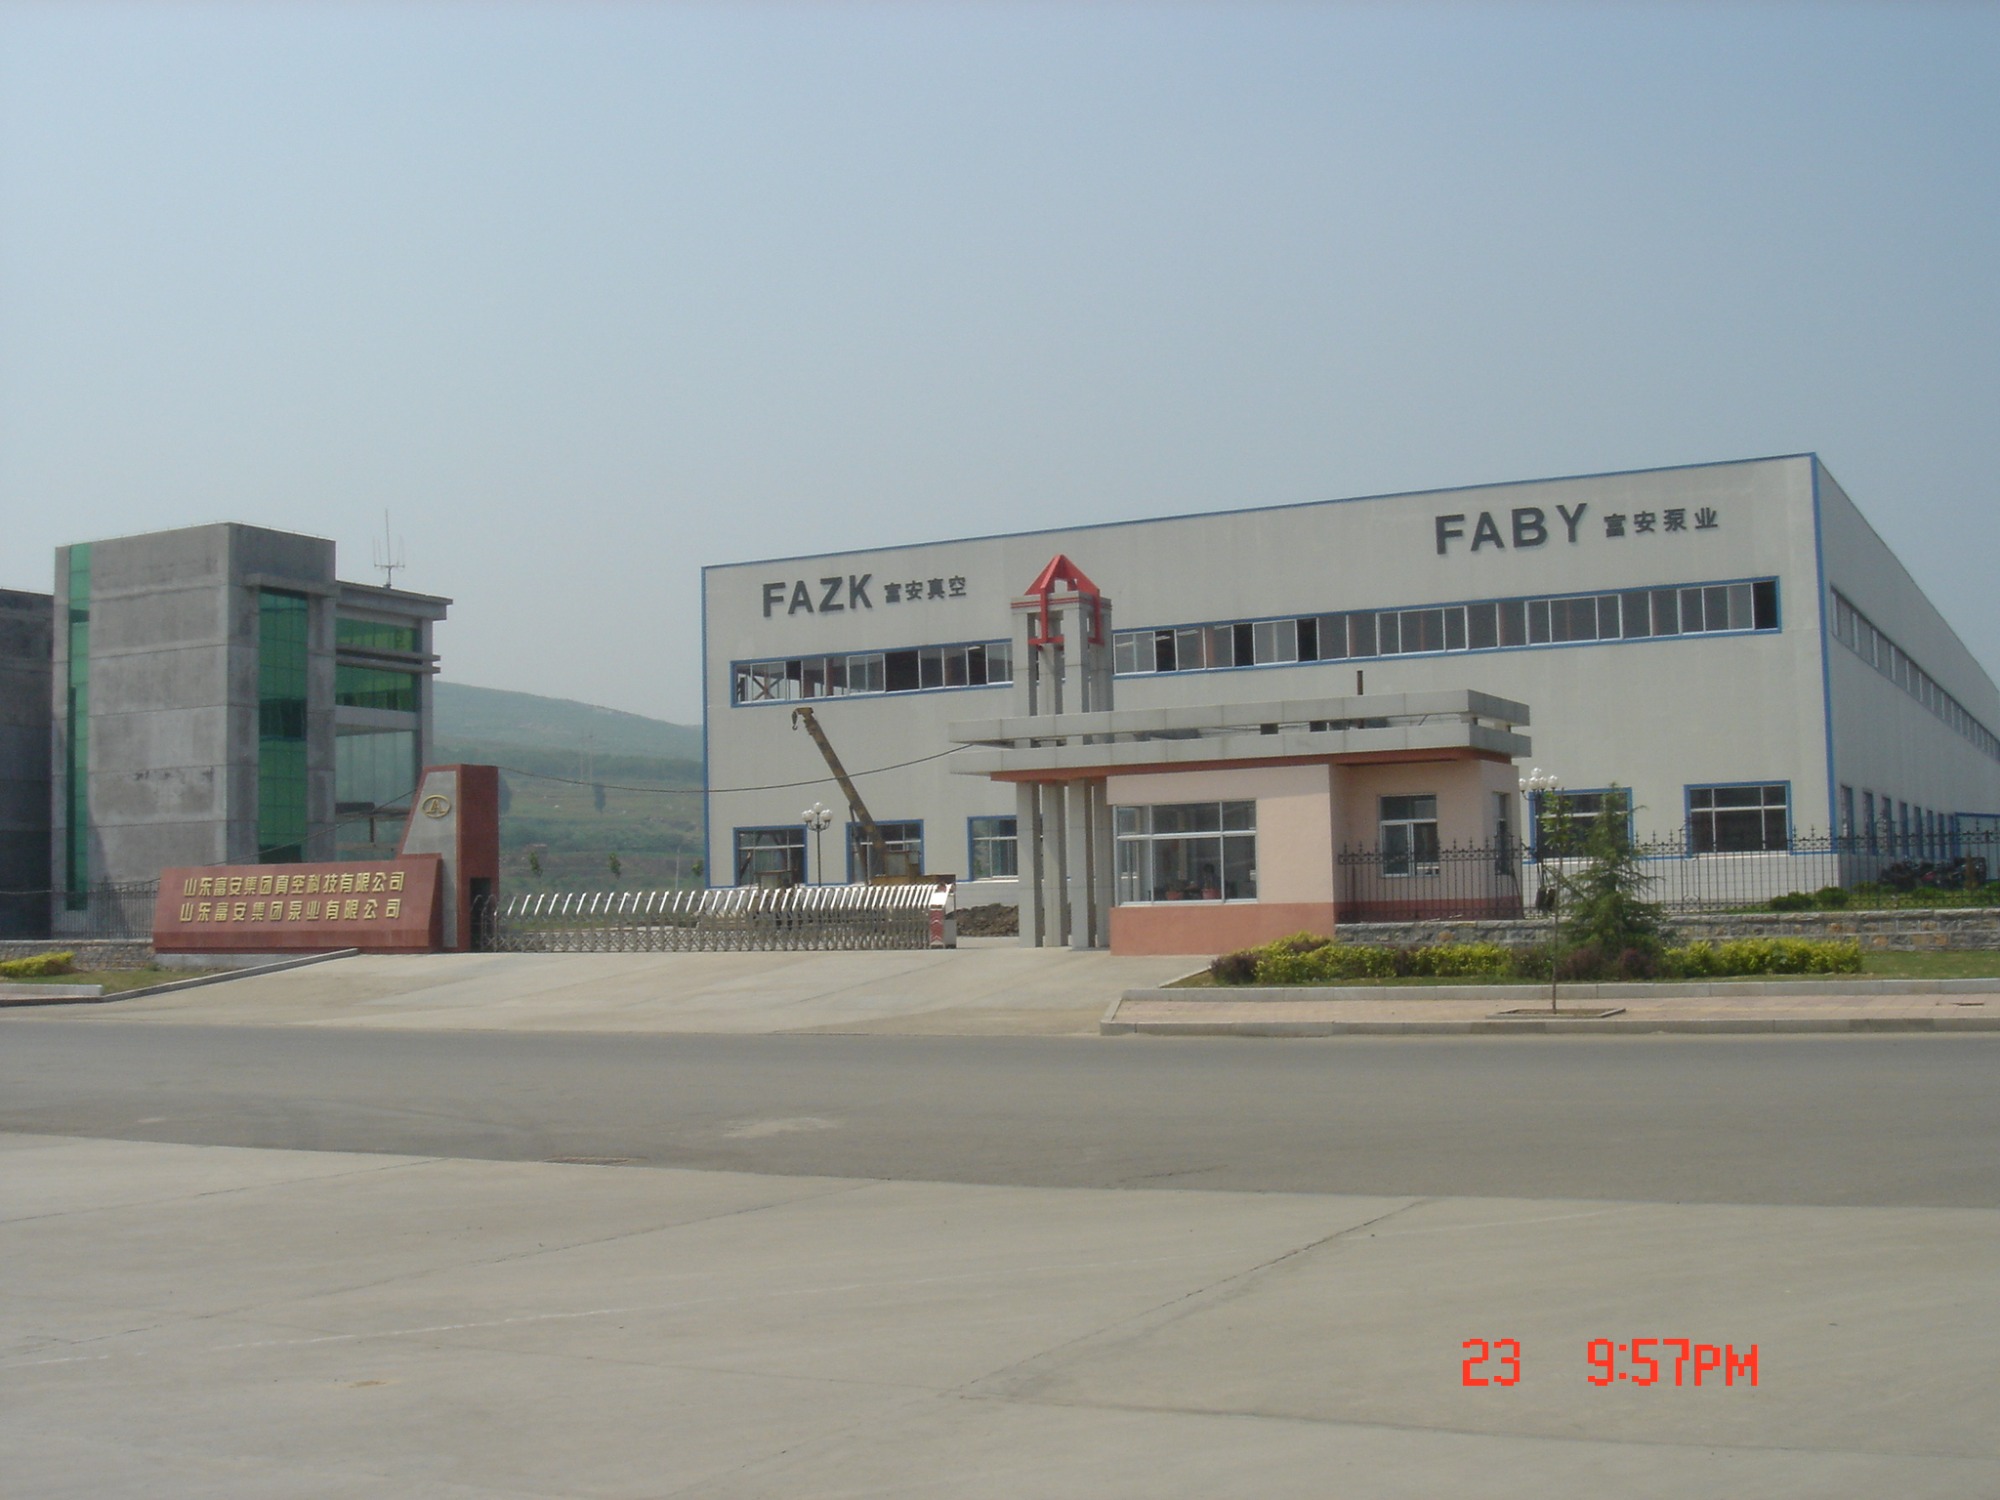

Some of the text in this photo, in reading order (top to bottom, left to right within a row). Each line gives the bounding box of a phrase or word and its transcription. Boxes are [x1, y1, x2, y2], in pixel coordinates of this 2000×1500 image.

[1435, 503, 1718, 555] FABY 富安泵业
[762, 574, 967, 617] FAZK 富安真空
[180, 898, 402, 922] 山东富安集团泵业有限公司
